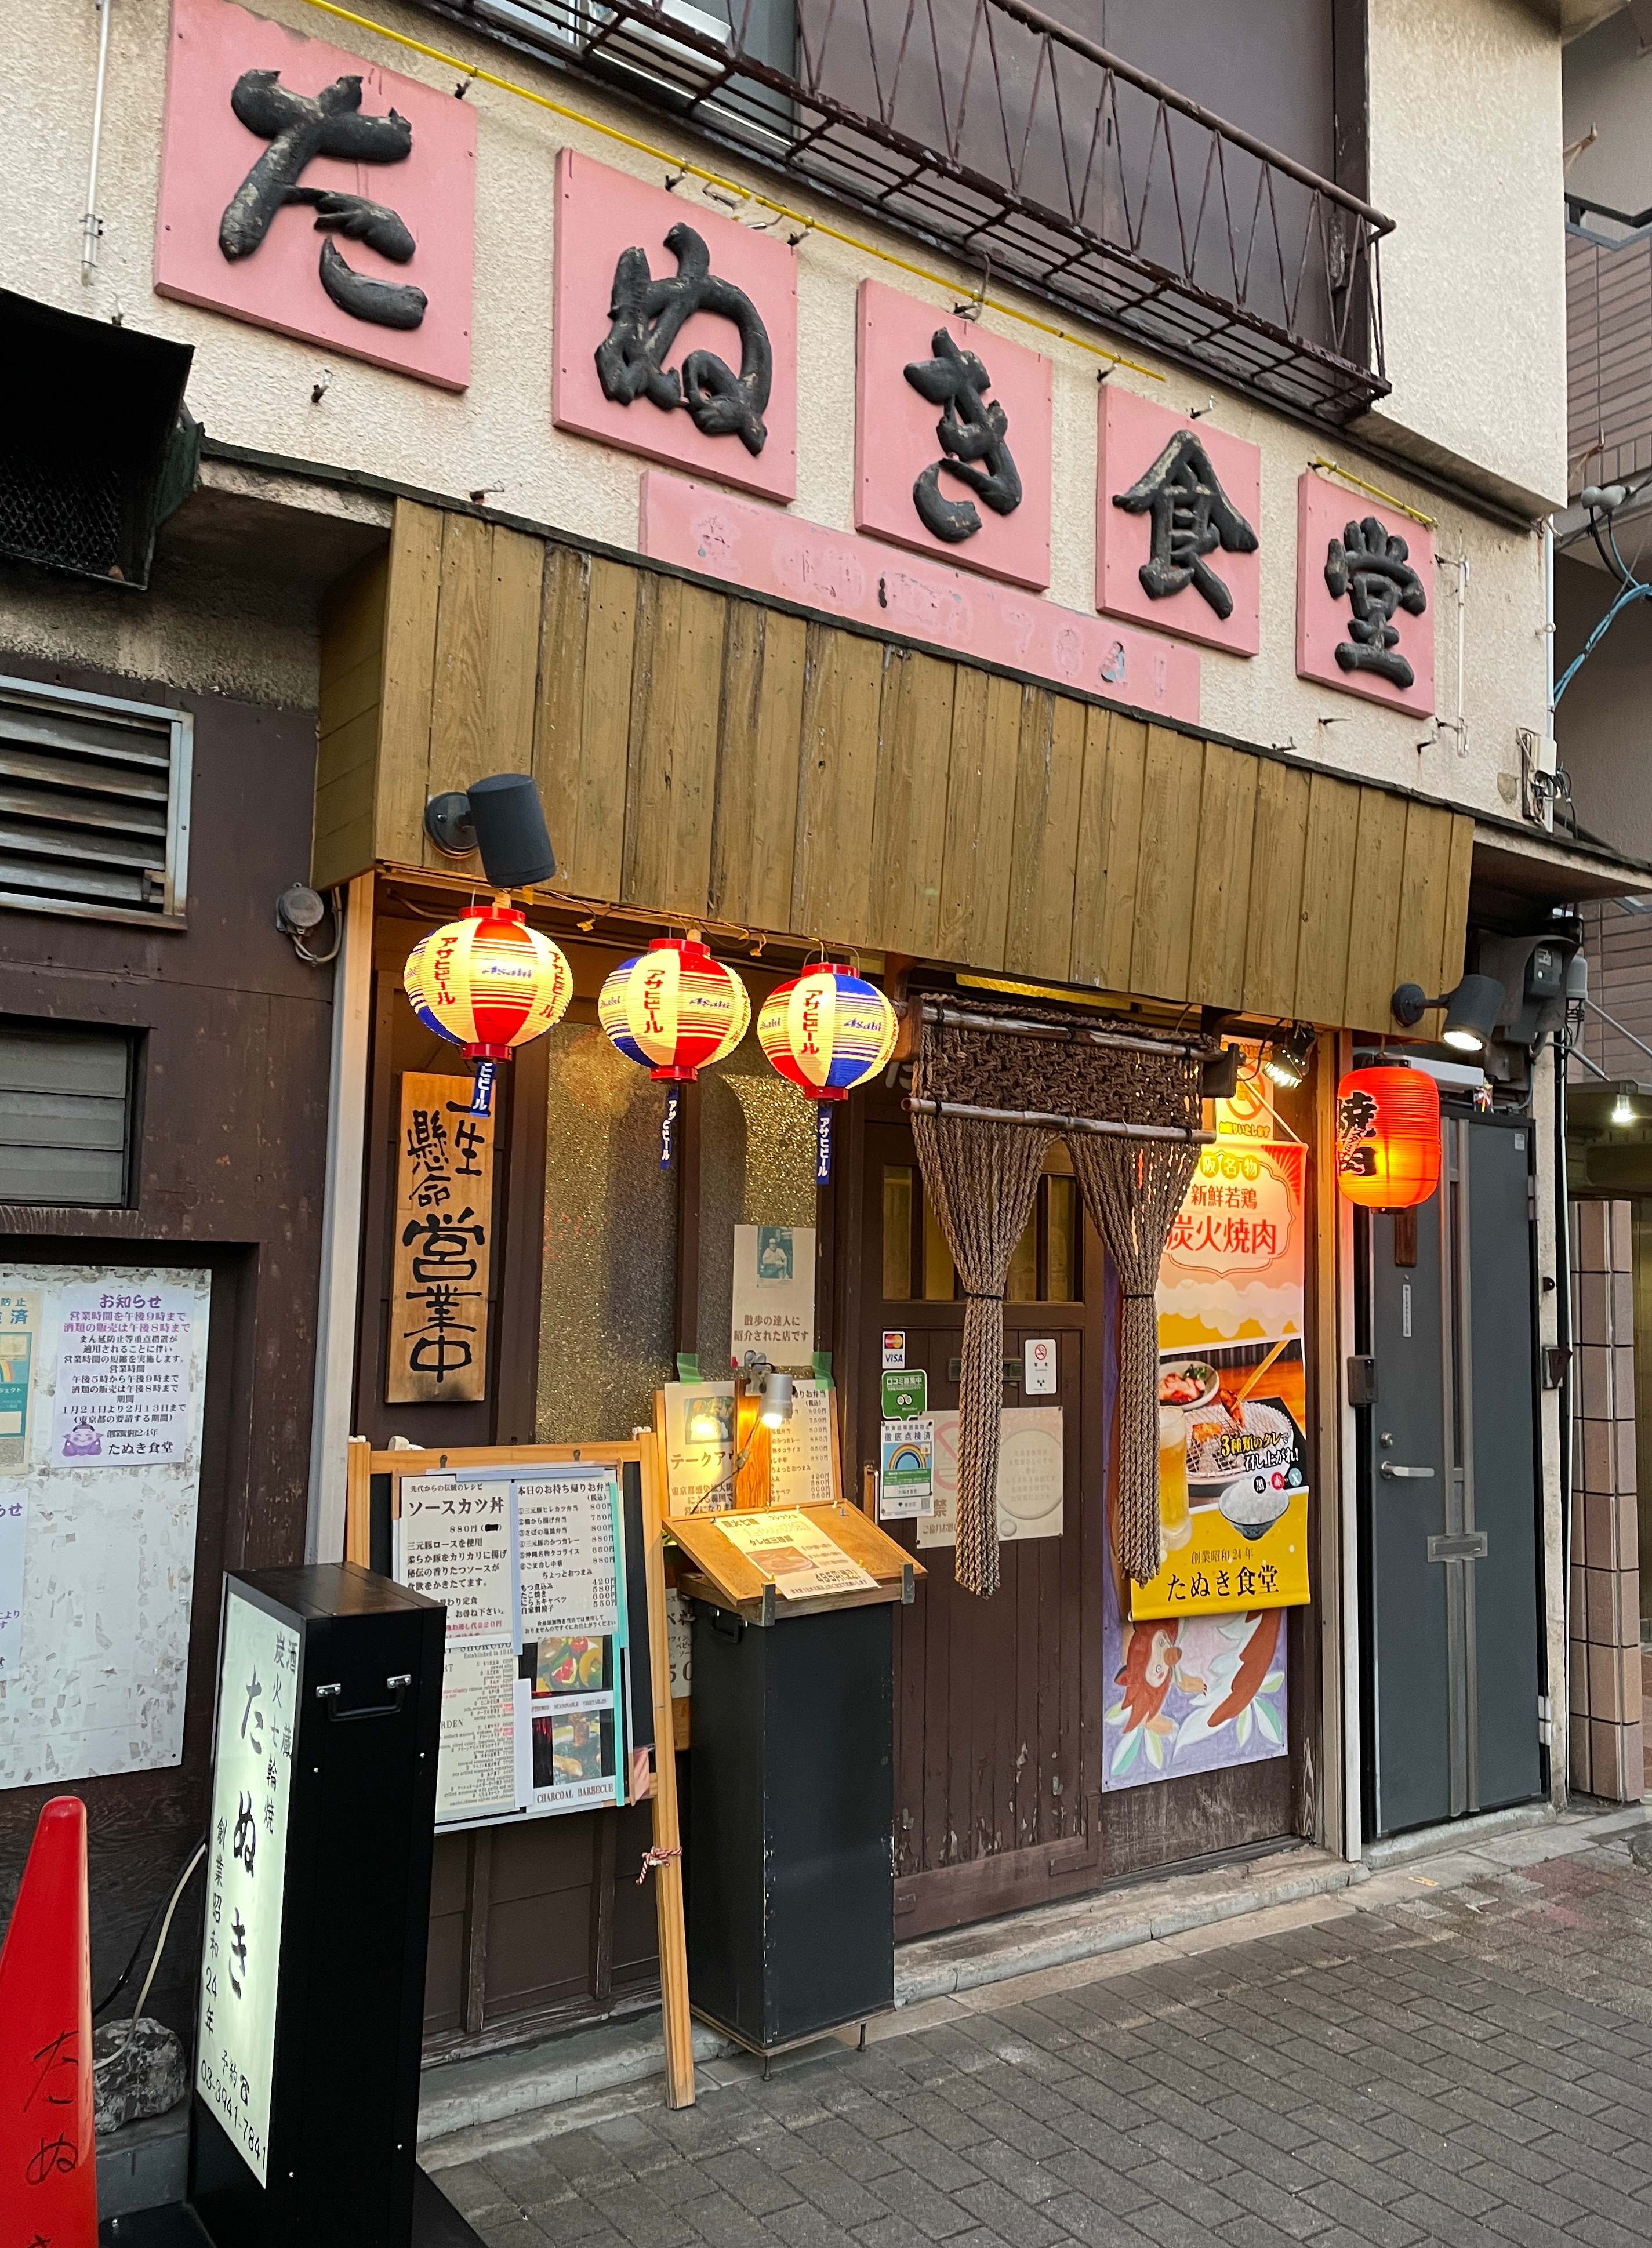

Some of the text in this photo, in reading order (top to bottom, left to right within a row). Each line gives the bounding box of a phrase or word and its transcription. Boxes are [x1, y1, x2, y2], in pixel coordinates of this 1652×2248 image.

[219, 68, 1426, 690] たぬき食堂
[481, 965, 532, 979] Asahi
[643, 969, 666, 1034] アサヒビール
[799, 990, 823, 1054] アサヒビール
[843, 1018, 882, 1032] Asahi
[816, 1117, 830, 1178] アサヒビール
[1190, 1184, 1257, 1210] 新鮮若鶏
[1165, 1215, 1277, 1255] 炭火焼肉
[99, 1294, 162, 1309] お知らせ
[402, 1206, 485, 1383] 営業中
[69, 1311, 186, 1322] 営業時間を午後9時まで
[744, 1314, 800, 1327] 散歩の達人に
[63, 1323, 190, 1333] 酒類の販売は午後8時まで
[734, 1330, 808, 1342] 紹介された店です
[885, 1354, 903, 1363] VISA
[109, 1364, 145, 1374] 営業時間
[72, 1374, 179, 1384] 午後5時から午後9時まで
[71, 1384, 179, 1394] 酒類の販売は午後8時まで
[116, 1394, 135, 1404] 期間
[62, 1404, 186, 1414] 1月21日より2月13日まで
[108, 1441, 174, 1456] たぬき食堂
[1221, 1432, 1290, 1457] 3種類のタレで
[409, 1496, 504, 1517] ソースカツ丼
[407, 1538, 482, 1551] 三元豚ロースを使用
[1167, 1564, 1280, 1602] たぬき食堂
[536, 1783, 613, 1804] CHARCOAL BARBECUE
[228, 1664, 264, 2000] たぬき
[201, 2059, 266, 2171] 03-3941-7841
[24, 2028, 80, 2248] たぬ
